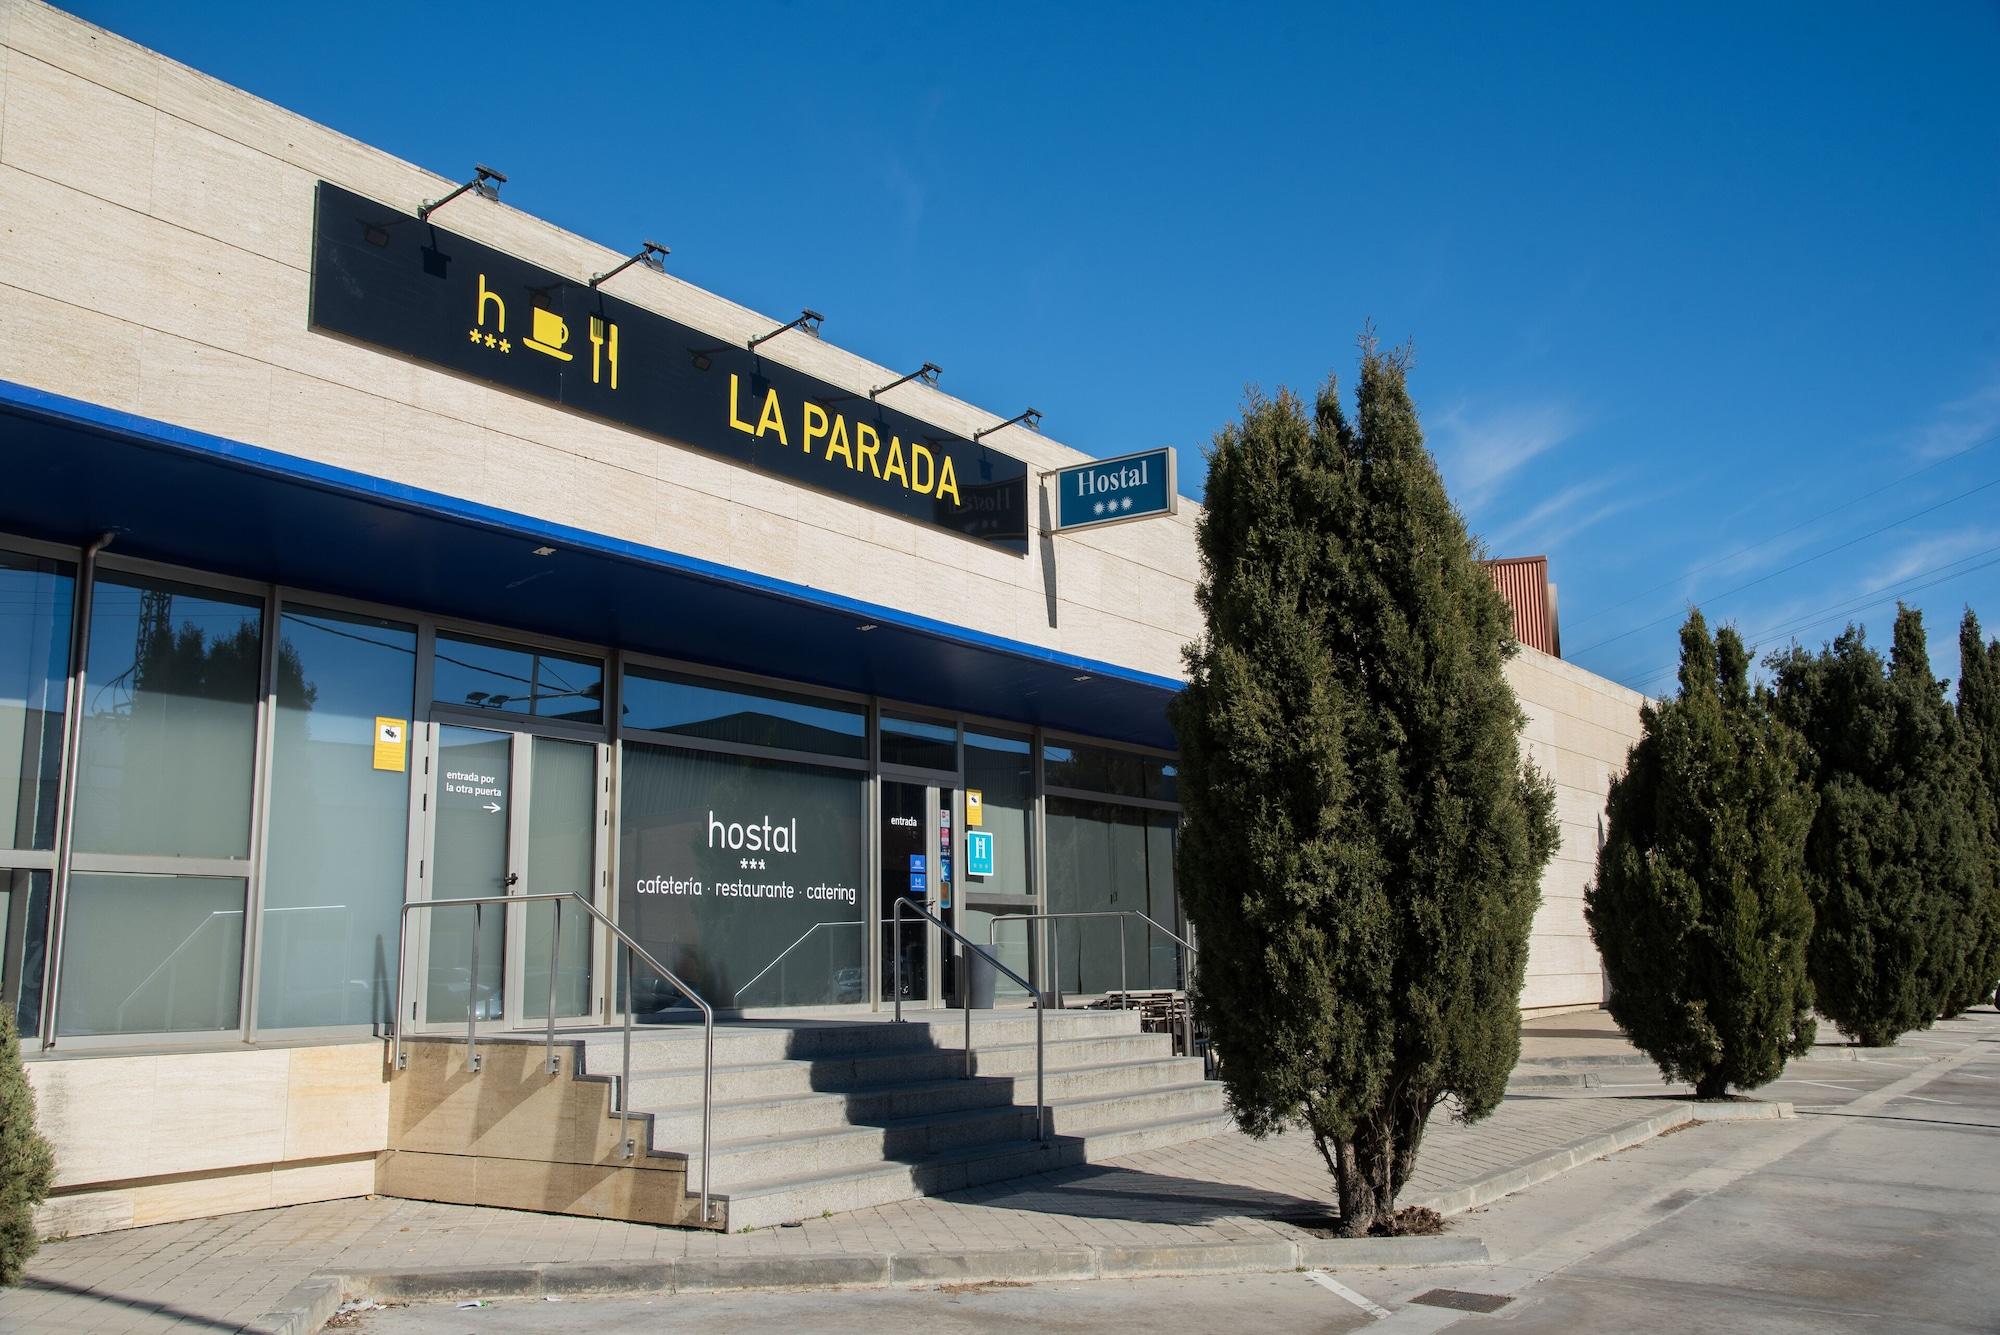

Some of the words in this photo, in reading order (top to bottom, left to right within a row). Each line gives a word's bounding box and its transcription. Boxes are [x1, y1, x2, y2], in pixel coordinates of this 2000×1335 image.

[476, 274, 506, 333] h
[729, 373, 789, 446] LA
[803, 401, 961, 506] PARADA
[1077, 460, 1148, 497] Hostal
[446, 770, 479, 783] entrada
[480, 775, 495, 785] por
[446, 782, 454, 792] la
[455, 784, 473, 794] otra
[474, 787, 502, 797] puerta
[708, 810, 797, 854] hostal
[890, 816, 917, 827] entrada
[636, 875, 702, 896] cafetería
[715, 879, 794, 899] restaurante
[806, 882, 856, 905] catering
